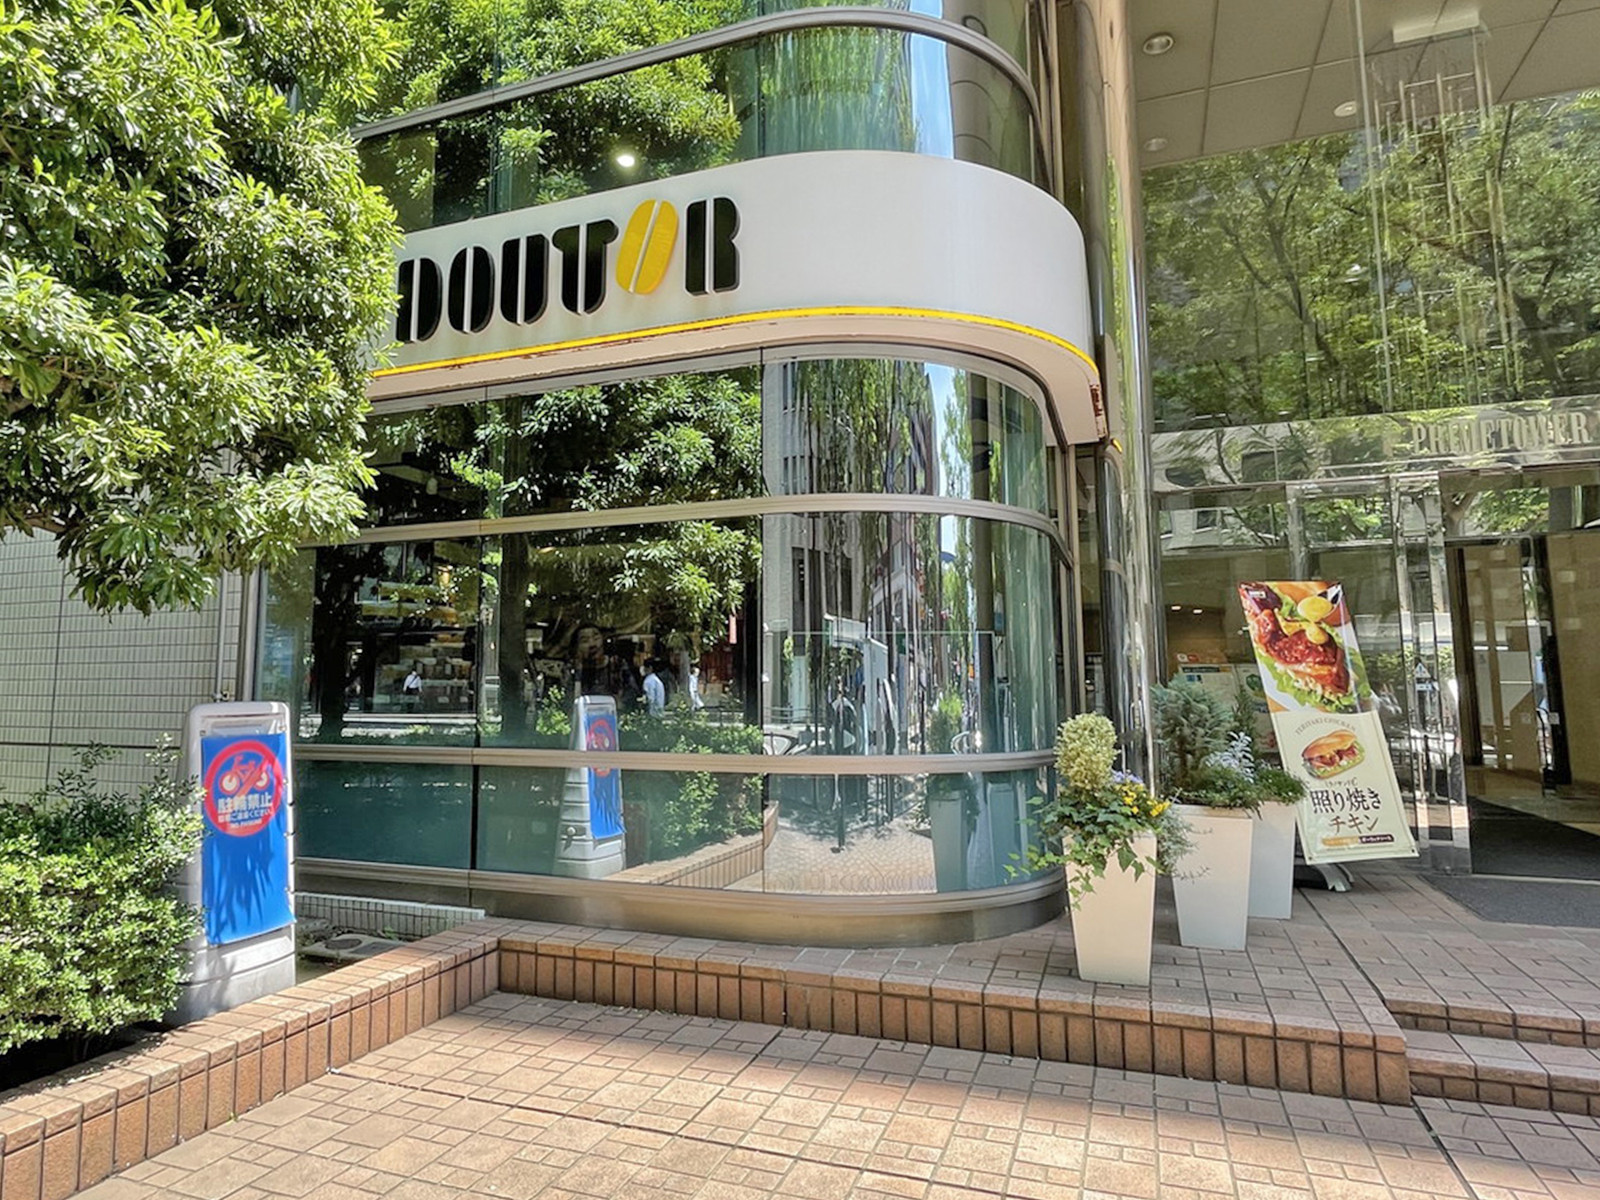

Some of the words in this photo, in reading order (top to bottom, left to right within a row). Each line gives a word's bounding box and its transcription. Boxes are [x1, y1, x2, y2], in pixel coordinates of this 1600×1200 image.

[396, 196, 741, 345] DOUTOR
[1310, 787, 1382, 814] 照り焼き
[1328, 813, 1379, 835] チキン
